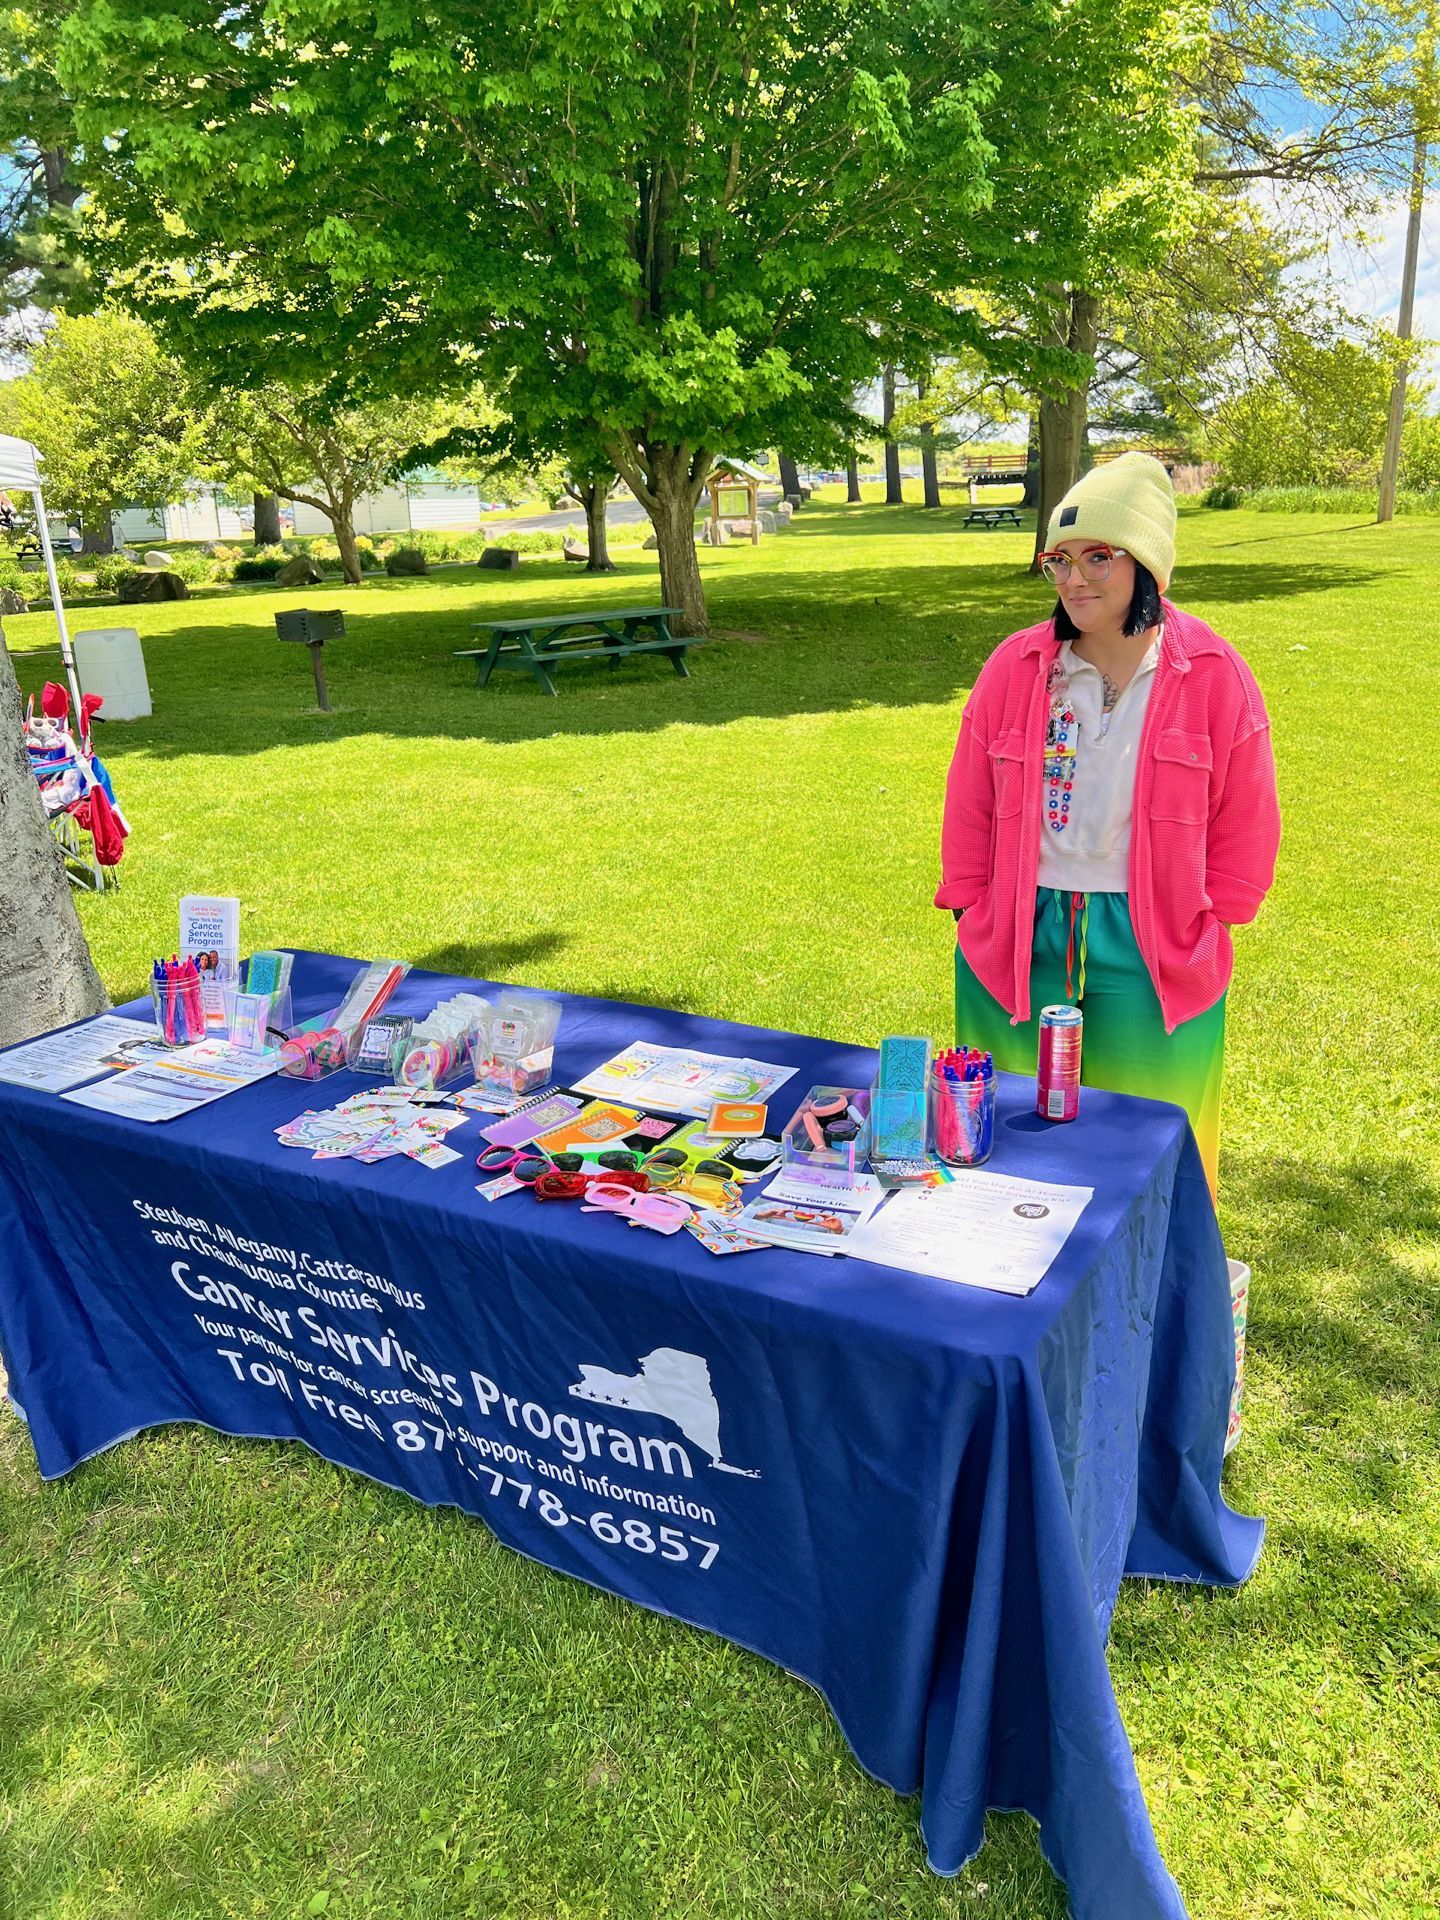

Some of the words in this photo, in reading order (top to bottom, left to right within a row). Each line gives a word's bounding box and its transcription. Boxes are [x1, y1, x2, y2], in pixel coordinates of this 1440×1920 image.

[188, 930, 224, 938] Services
[188, 937, 224, 947] Program
[191, 921, 221, 931] Cancer
[779, 1191, 802, 1201] Save
[806, 1197, 828, 1205] Your
[133, 1199, 217, 1241] Steuben,
[214, 1223, 304, 1270] Allegany,
[301, 1252, 426, 1311] Cattaraugus
[151, 1229, 190, 1250] and
[189, 1235, 296, 1290] Chautauqua
[296, 1273, 383, 1313] Counties
[170, 1261, 293, 1340] Cancer
[298, 1307, 463, 1407] Services
[470, 1371, 694, 1479] Program
[193, 1313, 237, 1338] Your
[238, 1326, 291, 1362] partner
[289, 1349, 316, 1375] for
[318, 1364, 368, 1400] cancer
[370, 1388, 456, 1441] screeni,
[457, 1426, 535, 1470] support
[537, 1458, 576, 1487] and
[579, 1470, 718, 1527] information
[217, 1348, 294, 1401] Toll
[299, 1378, 386, 1442] Free
[391, 1419, 722, 1571] 87-778-6857
